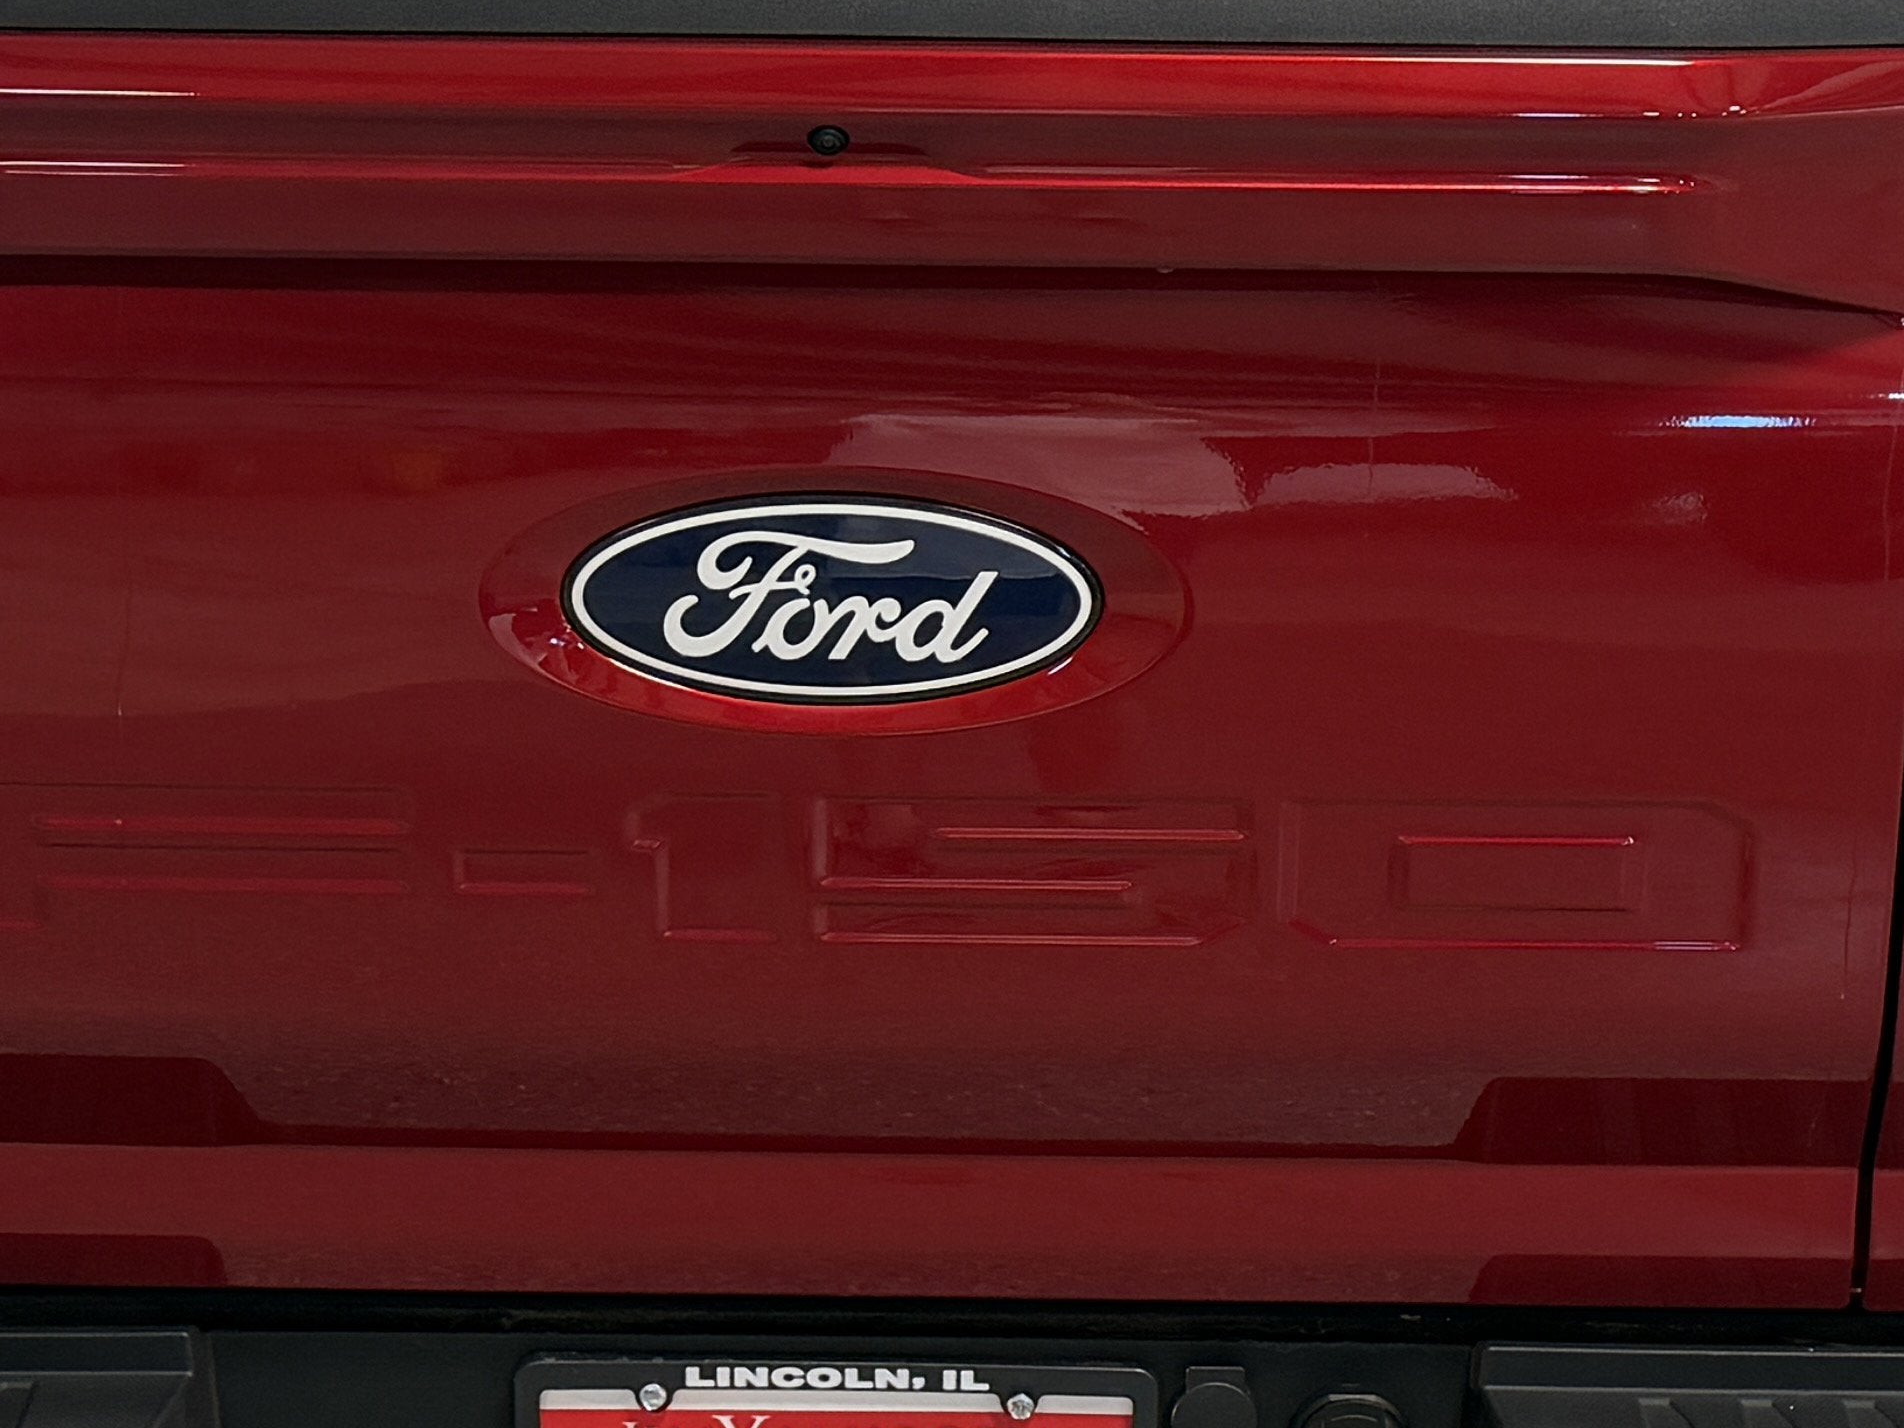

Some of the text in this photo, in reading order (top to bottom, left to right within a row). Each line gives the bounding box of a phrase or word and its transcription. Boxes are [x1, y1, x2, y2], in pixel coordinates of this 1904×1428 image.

[662, 530, 999, 664] Ford
[685, 1365, 991, 1392] LINCOLN, IL
